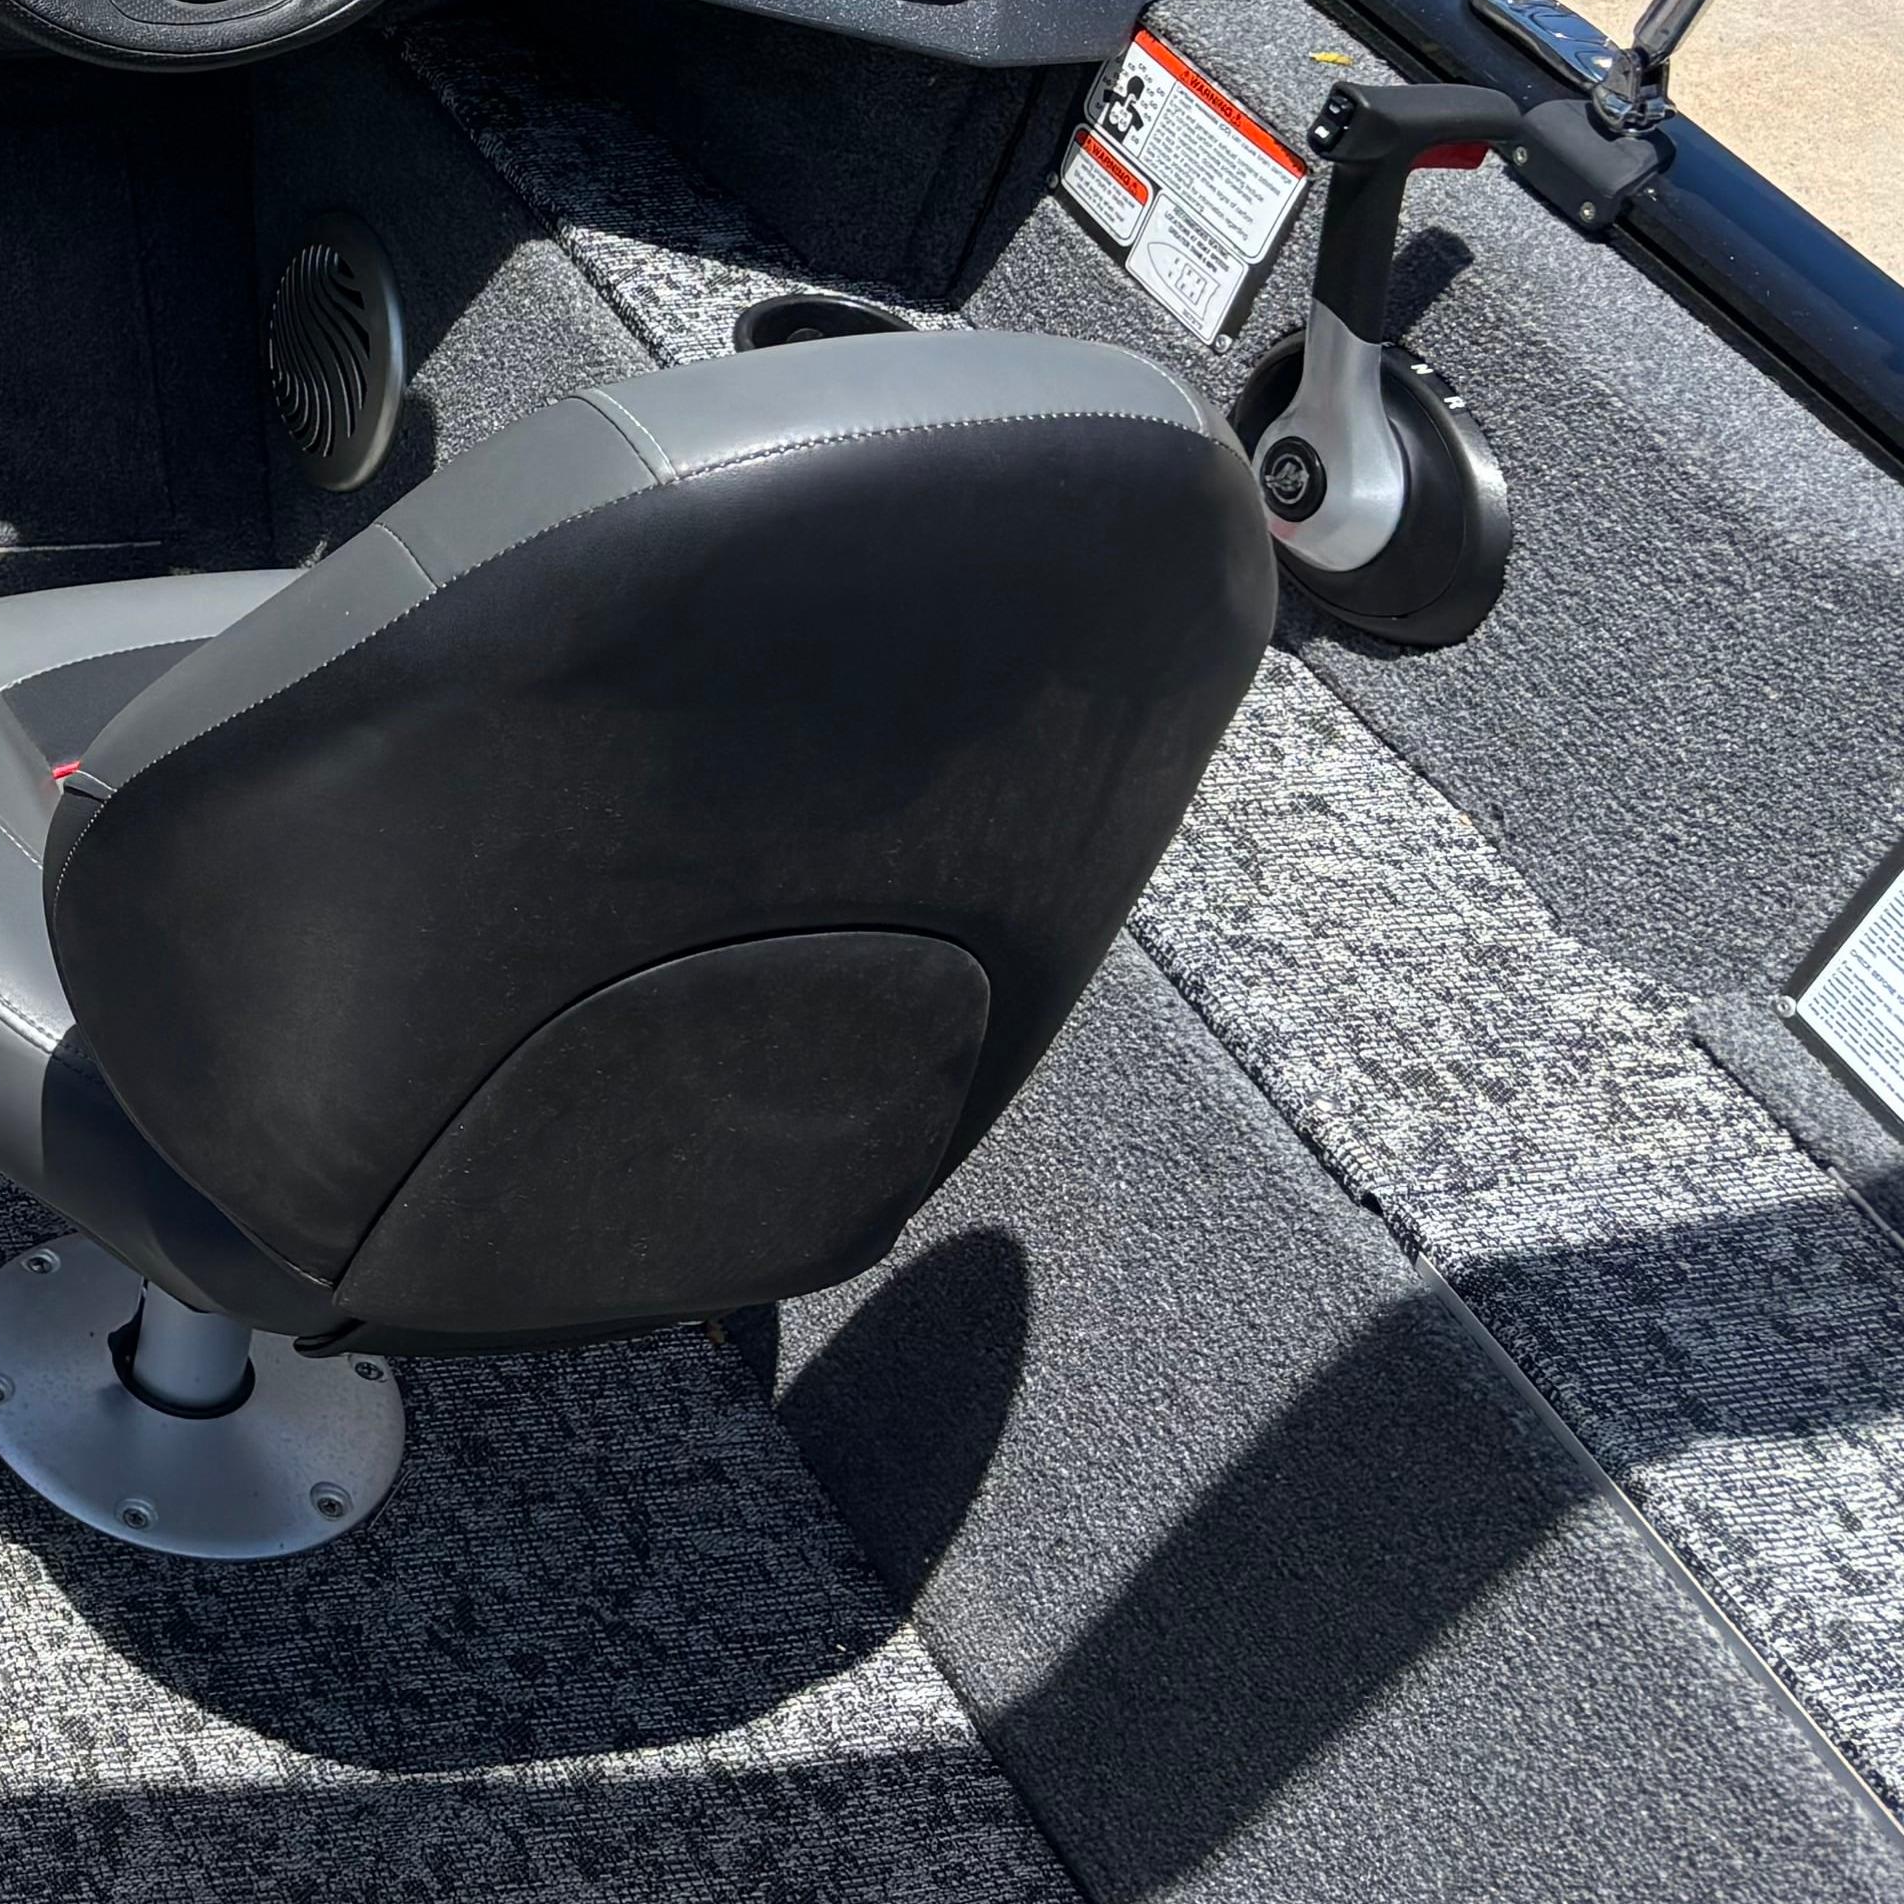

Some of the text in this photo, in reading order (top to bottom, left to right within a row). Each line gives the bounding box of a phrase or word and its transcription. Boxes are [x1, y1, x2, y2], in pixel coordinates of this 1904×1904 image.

[1190, 75, 1233, 118] WARNING
[1092, 144, 1130, 186] WARNING
[1410, 363, 1434, 375] N
[1444, 396, 1465, 410] R
